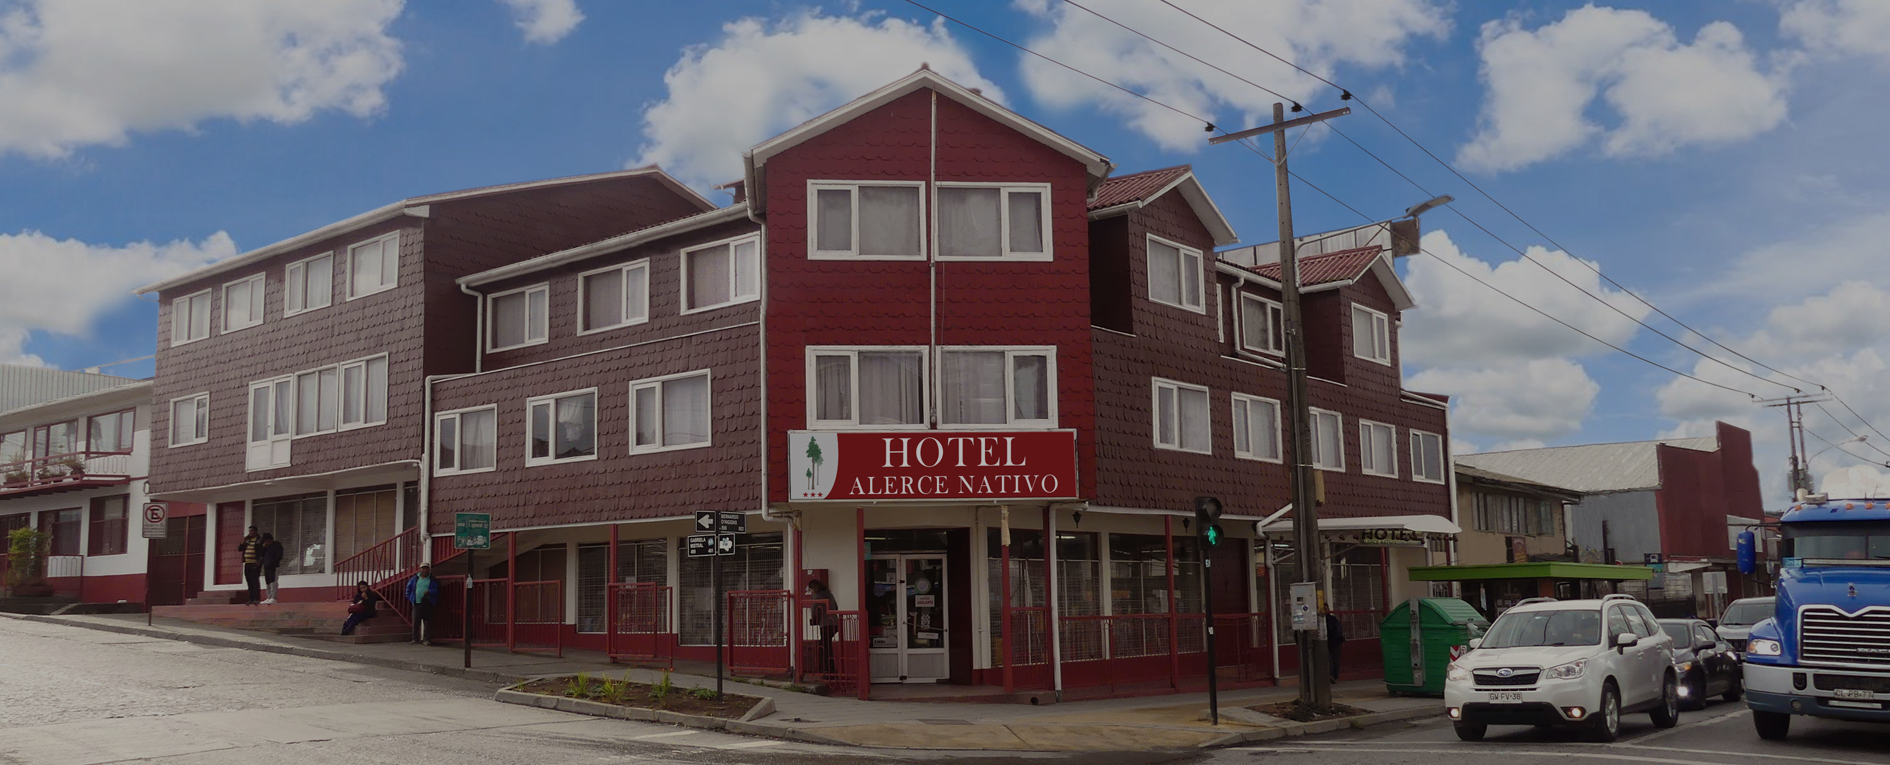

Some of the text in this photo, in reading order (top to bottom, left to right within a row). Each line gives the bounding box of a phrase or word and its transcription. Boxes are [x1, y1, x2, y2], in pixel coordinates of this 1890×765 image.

[882, 436, 1027, 468] HOTEL
[849, 473, 1059, 496] ALERCE NATIVO
[1362, 528, 1423, 541] HOTEL
